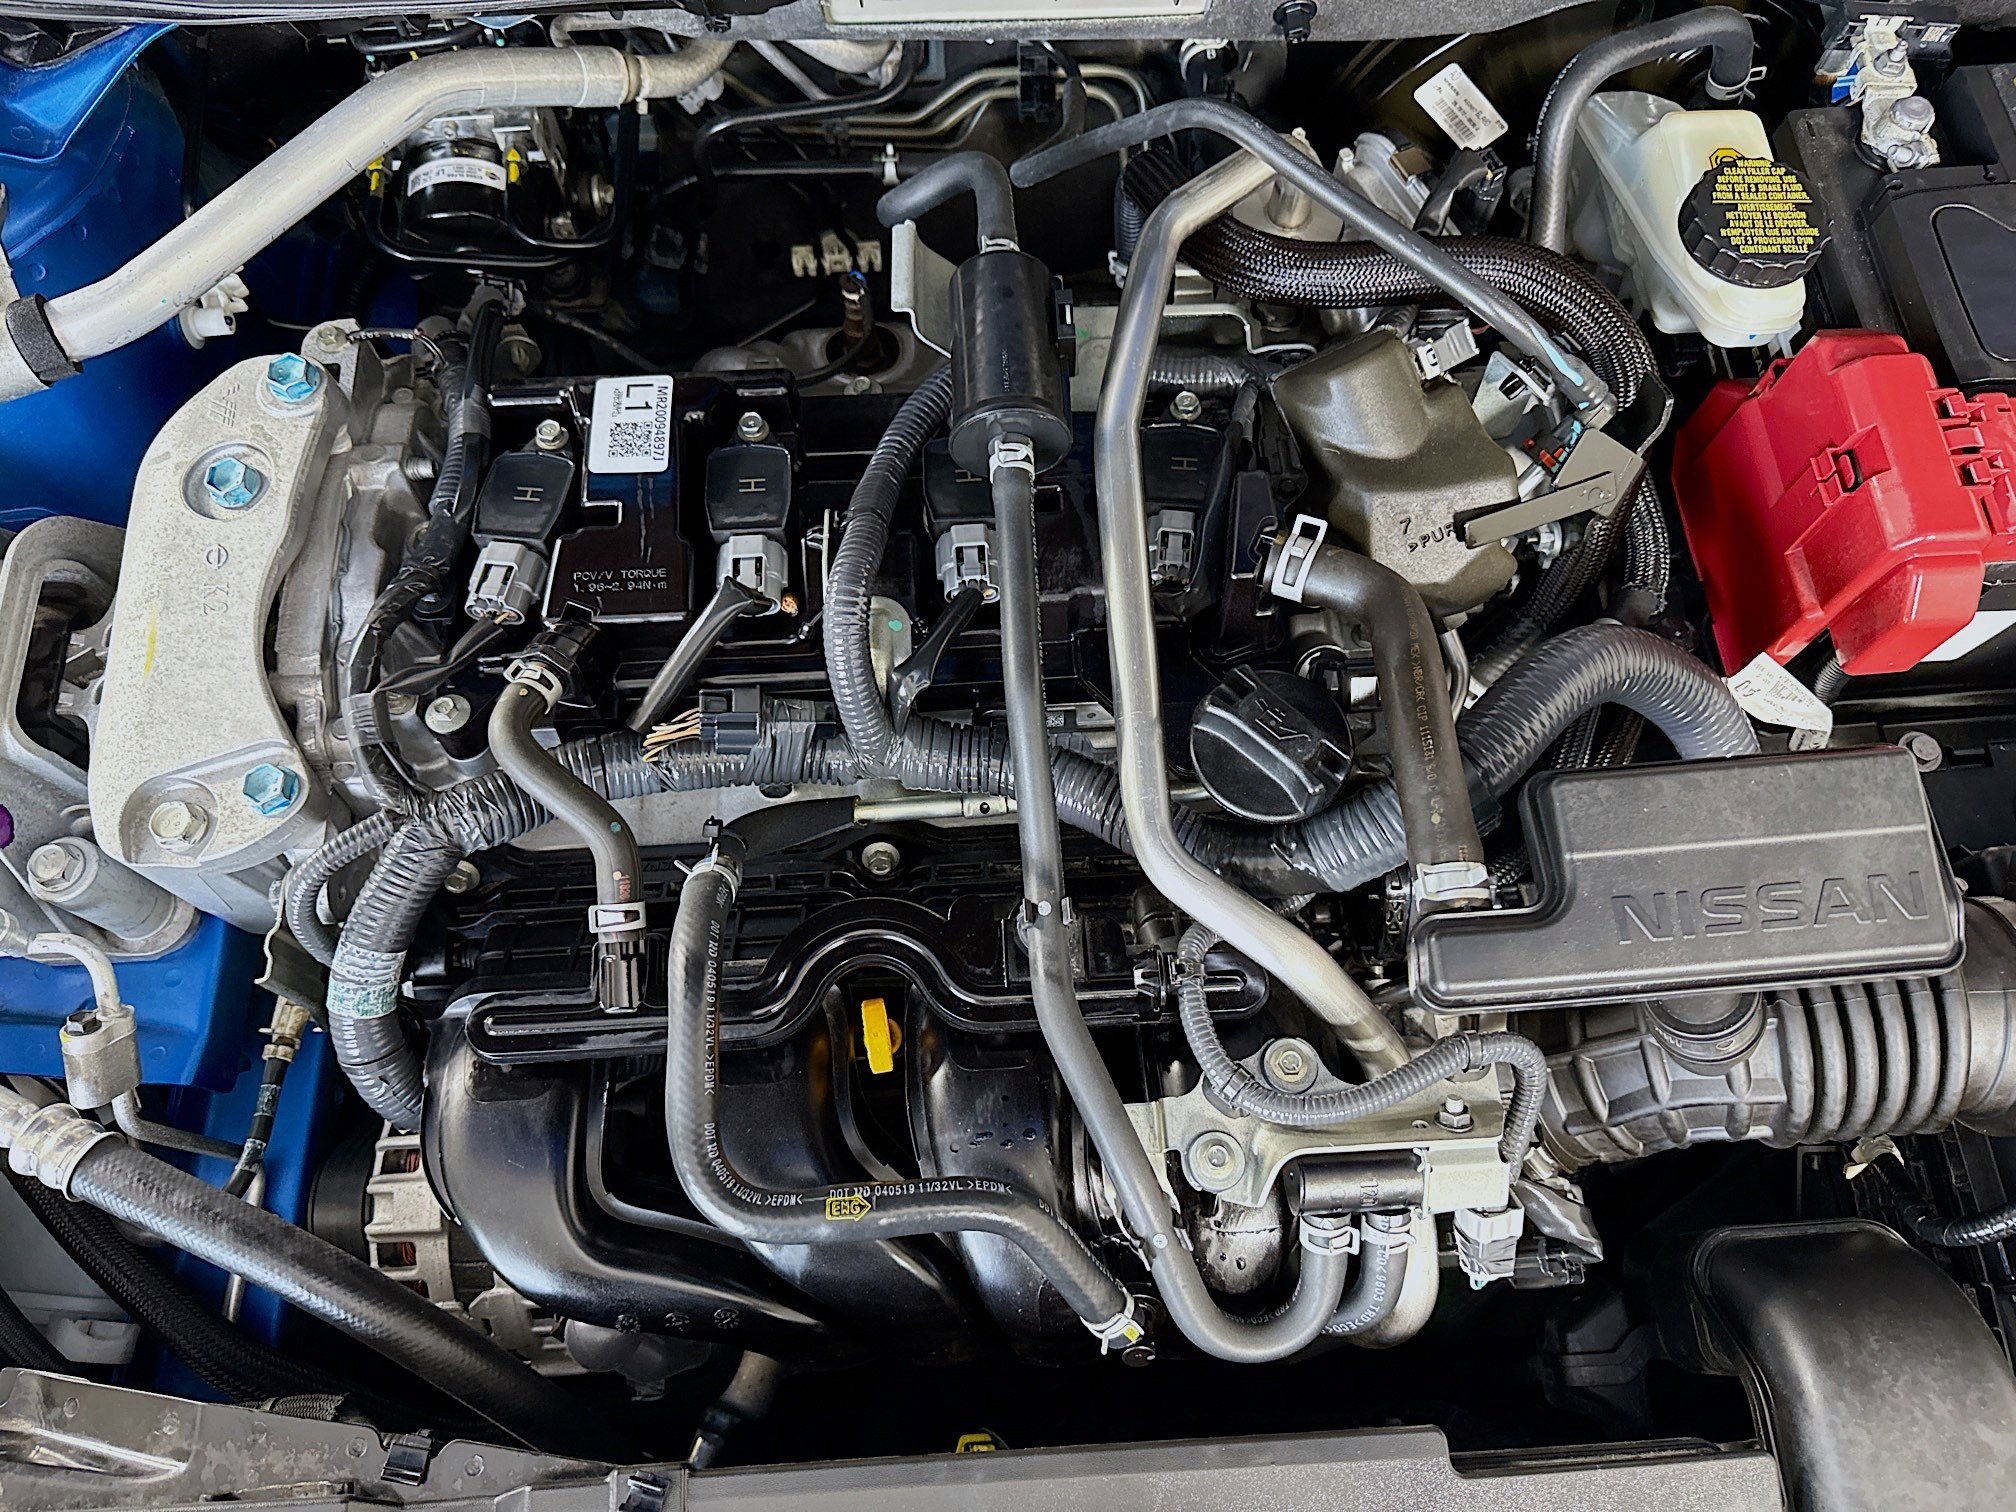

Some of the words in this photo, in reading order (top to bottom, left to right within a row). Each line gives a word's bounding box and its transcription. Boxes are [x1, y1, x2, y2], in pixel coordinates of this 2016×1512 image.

[1723, 167, 1747, 176] CLEAN
[1748, 167, 1770, 176] FILLER
[1771, 167, 1786, 175] CAP
[1717, 175, 1744, 183] BEFORE
[1783, 175, 1797, 183] USE
[1715, 184, 1732, 192] ONLY
[1750, 184, 1756, 192] 3
[1758, 184, 1782, 192] BRAKE
[1712, 192, 1733, 200] FROM
[1735, 192, 1740, 200] A
[1741, 192, 1767, 200] SEALED
[1725, 211, 1762, 219] NETTOYER
[1763, 211, 1772, 219] LE
[1774, 211, 1806, 219] BOUCHON
[1729, 220, 1754, 228] AVANT
[1755, 220, 1764, 228] DE
[1765, 219, 1774, 228] LE
[1765, 228, 1780, 236] QUE
[1781, 228, 1791, 236] DU
[1792, 228, 1820, 236] LIQUIDE
[1731, 237, 1745, 245] DOT
[1753, 237, 1795, 245] PROVENANT
[1740, 245, 1781, 254] CONTENANT
[625, 383, 654, 411] L1
[652, 385, 669, 461] MR20094897J
[573, 571, 613, 581] PCV/V
[620, 568, 667, 579] TORQUE
[1611, 871, 1929, 945] NISSAN
[711, 920, 720, 940] DOT
[706, 961, 717, 1003] 040519
[704, 1122, 717, 1140] DOT
[711, 1158, 736, 1189] 040519
[874, 1183, 915, 1197] 040519
[831, 1200, 861, 1216] ENG
